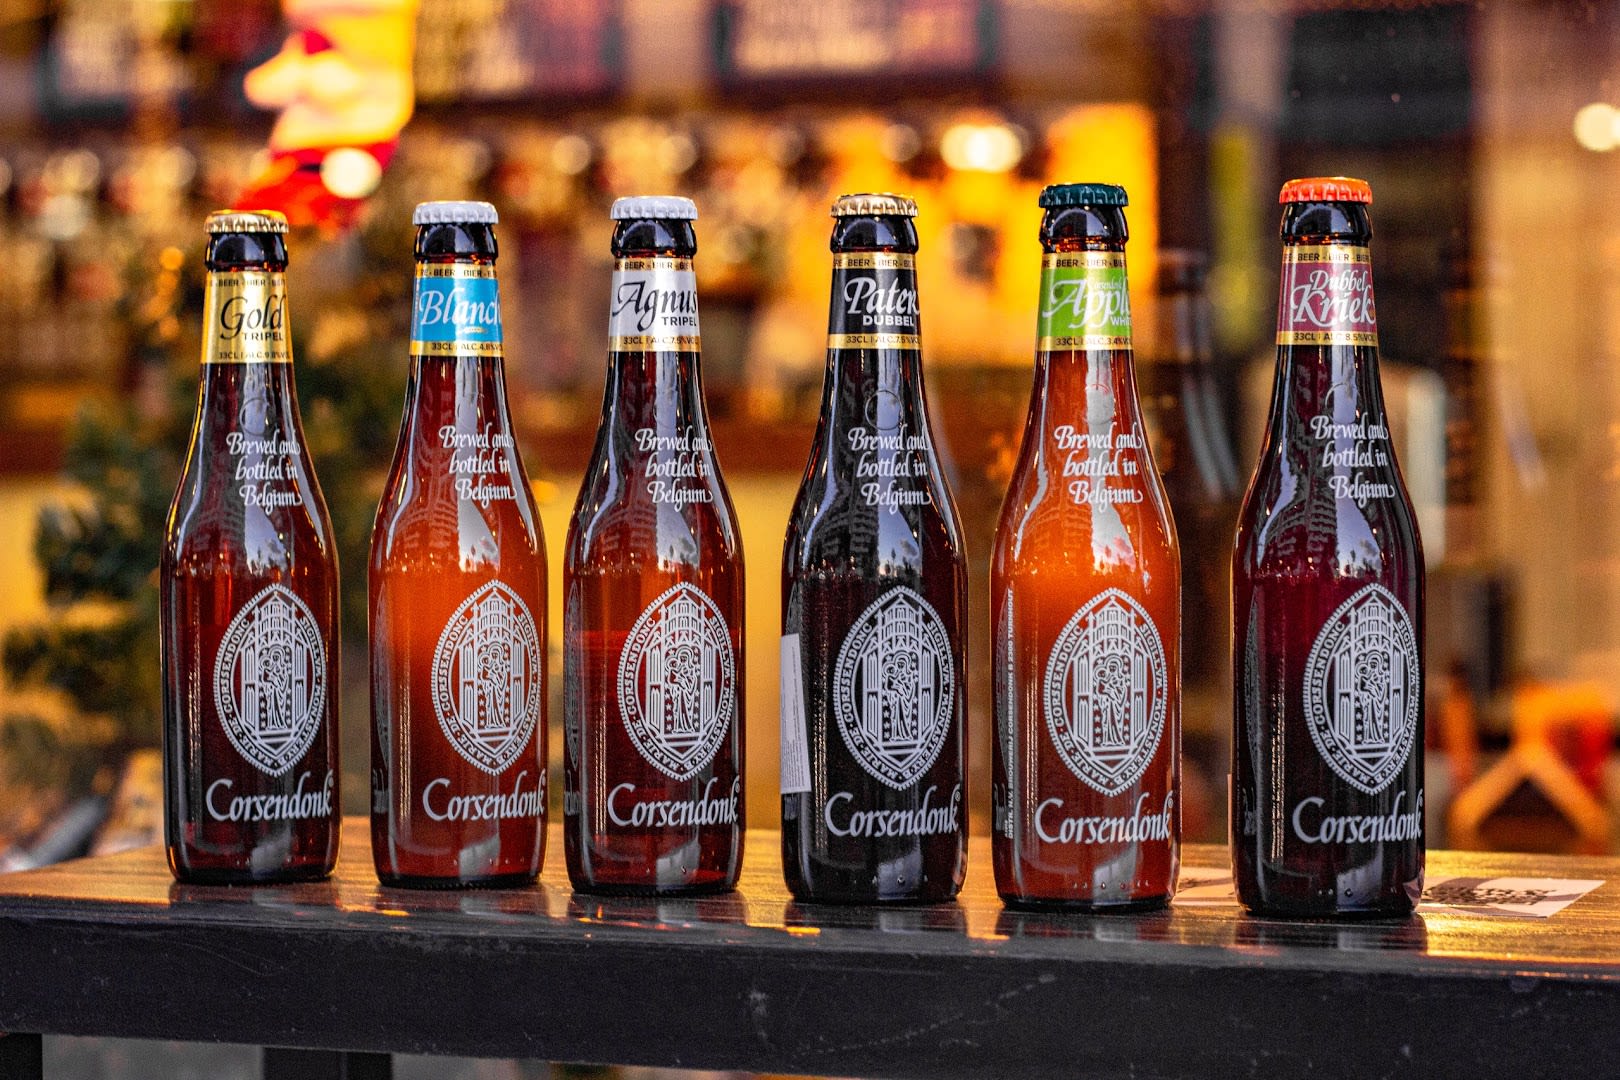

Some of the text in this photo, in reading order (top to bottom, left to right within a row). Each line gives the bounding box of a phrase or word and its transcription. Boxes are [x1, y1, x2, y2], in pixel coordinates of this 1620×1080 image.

[624, 262, 645, 270] BEER
[848, 259, 870, 267] BEER
[1056, 259, 1079, 267] BEER
[1297, 253, 1320, 261] BEER
[1310, 269, 1368, 291] Dubbel
[612, 280, 697, 333] Agnus
[844, 276, 920, 315] Pater
[1290, 284, 1376, 328] Kriek
[220, 294, 287, 340] Gold
[661, 317, 697, 327] TRIPEL
[862, 315, 915, 327] DUBBEL
[243, 332, 284, 341] TRIPEL
[846, 335, 868, 344] 33CL
[1056, 338, 1079, 346] 33CL
[1294, 333, 1316, 341] 33CL
[439, 423, 514, 448] Brewed and
[635, 425, 712, 451] Brewed and
[848, 424, 929, 450] Brewed and
[1054, 422, 1142, 449] Brewed and
[1310, 412, 1388, 439] Brewed and
[226, 429, 300, 455] Brewed and
[1322, 441, 1388, 467] bottled in
[235, 456, 298, 480] bottled in
[449, 449, 511, 474] bottled in
[645, 452, 710, 477] bottled in
[856, 451, 927, 477] bottled in
[1063, 450, 1138, 477] bottled in
[239, 482, 302, 515] Belgium
[455, 475, 517, 509] Belgium
[647, 478, 713, 512] Belgium
[861, 480, 931, 515] Belgium
[1069, 477, 1143, 513] Belgium
[1328, 472, 1395, 508] Belgium
[632, 719, 646, 737] DE
[850, 727, 864, 745] DE
[1059, 731, 1075, 751] DE
[641, 740, 679, 771] MARIE
[861, 748, 897, 780] MARIE
[1072, 752, 1109, 786] MARIE
[205, 768, 334, 822] Corsendonk
[422, 768, 547, 822] Corsendonk
[607, 775, 740, 828] Corsendonk
[824, 784, 961, 838] Corsendonk
[1034, 790, 1174, 845] Corsendonk
[1292, 788, 1424, 845] Corsendonk
